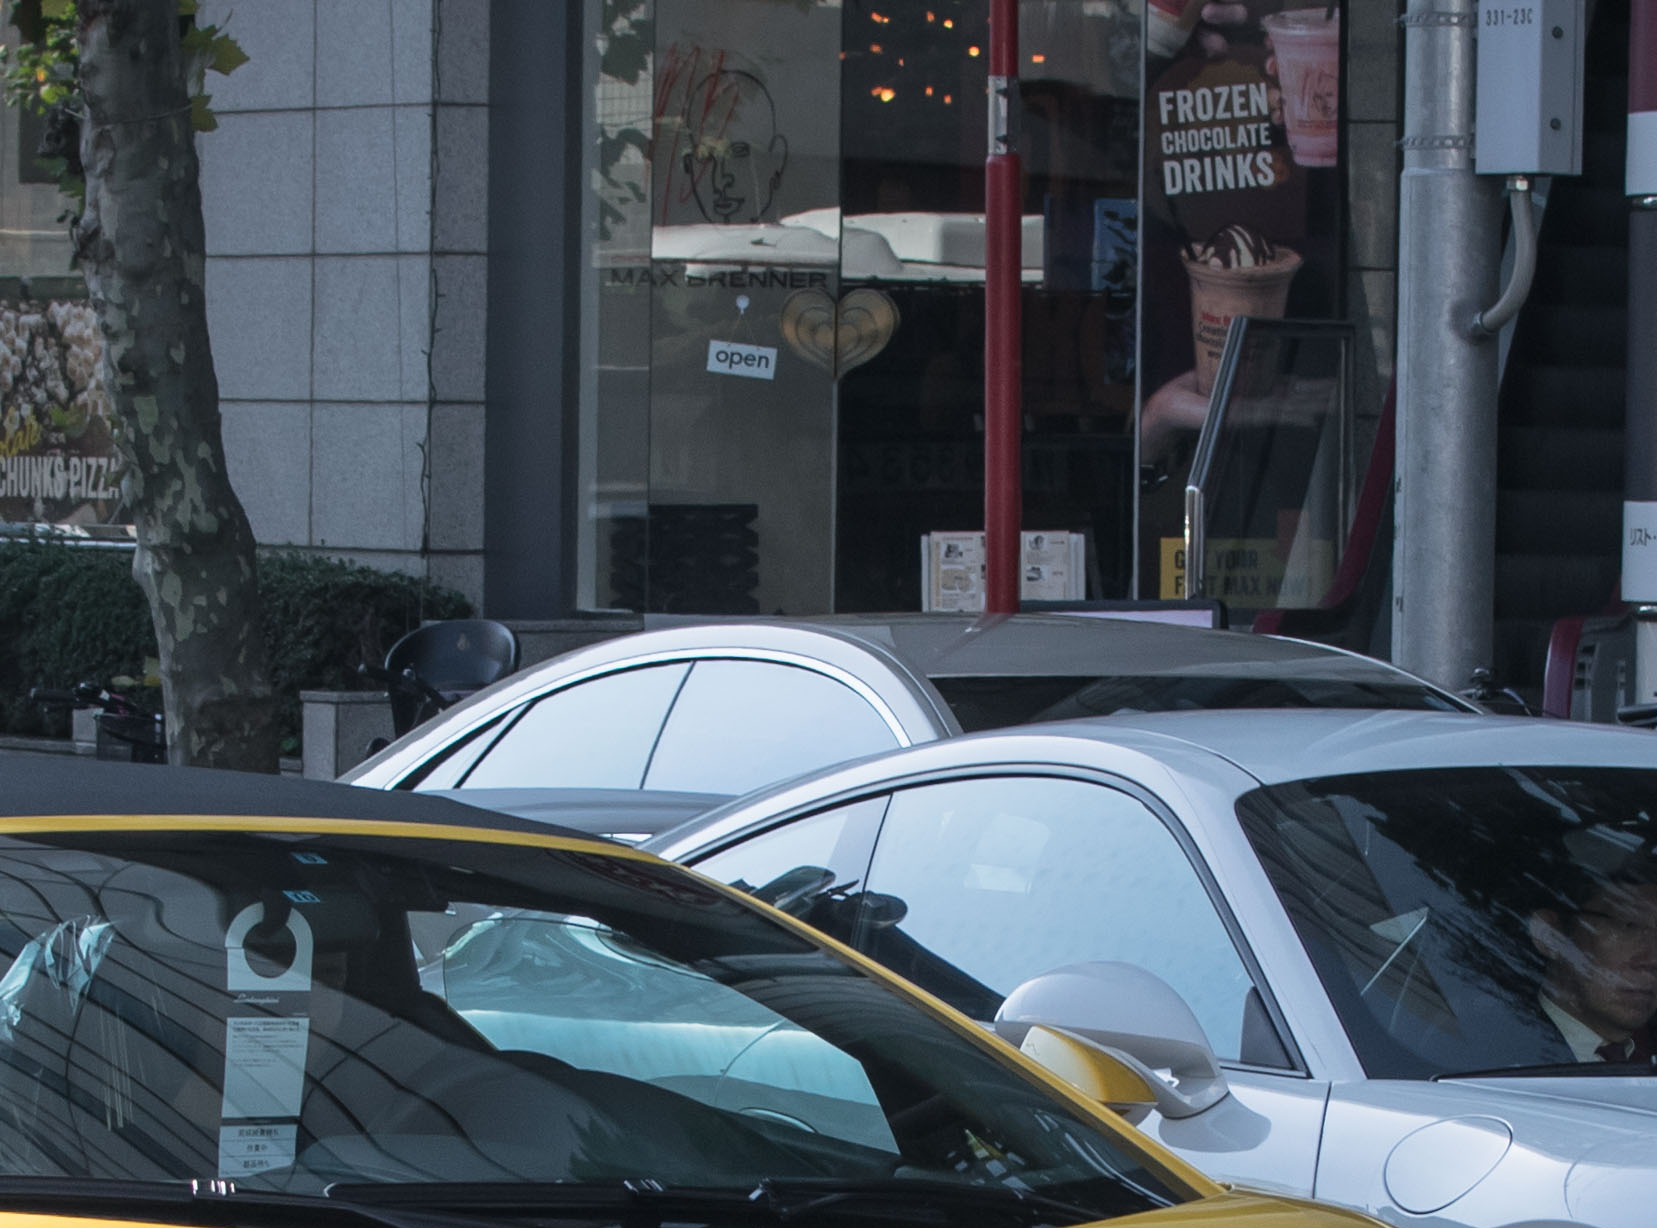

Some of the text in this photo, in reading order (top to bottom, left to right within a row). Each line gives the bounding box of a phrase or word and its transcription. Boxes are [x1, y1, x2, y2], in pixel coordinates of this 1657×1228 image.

[1158, 82, 1269, 125] FROZEN
[1161, 122, 1273, 155] CHOCOLATE
[1163, 151, 1276, 196] DRINKS
[610, 267, 679, 288] MAX
[715, 349, 770, 370] open
